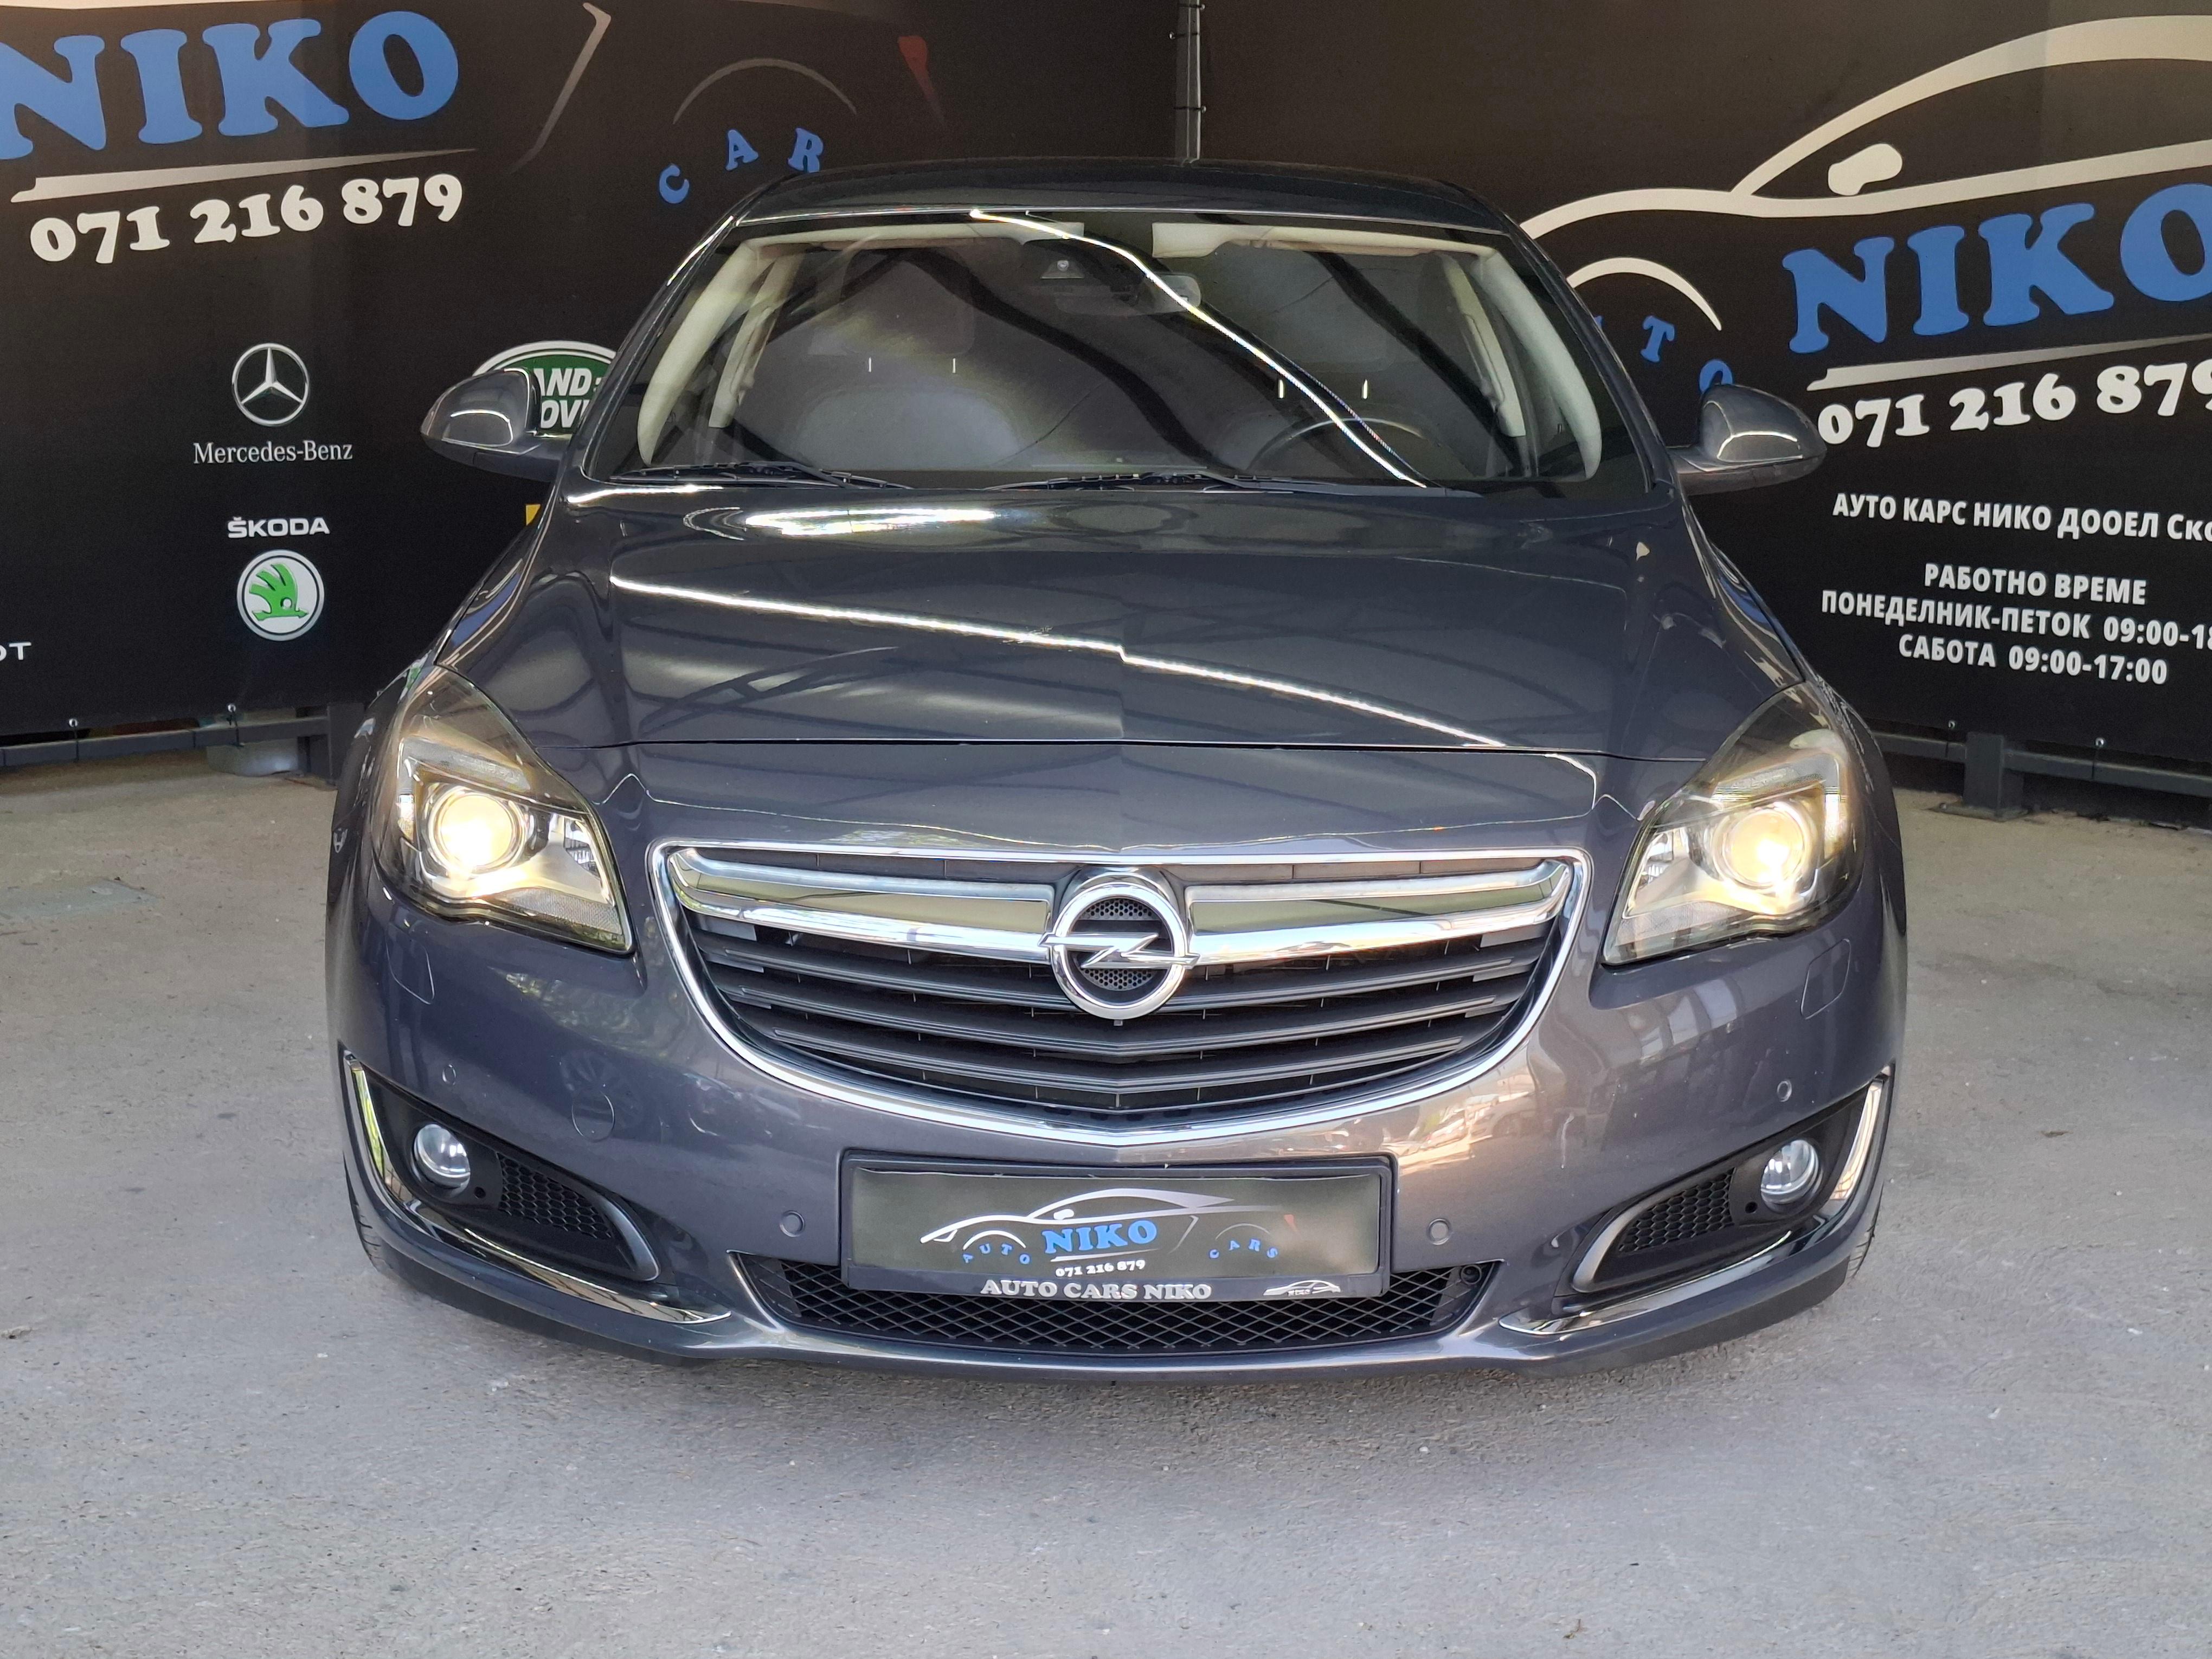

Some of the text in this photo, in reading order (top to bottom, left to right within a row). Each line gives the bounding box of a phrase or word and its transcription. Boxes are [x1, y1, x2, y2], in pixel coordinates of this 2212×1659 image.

[0, 11, 458, 158] NIKO
[30, 173, 462, 264] 071 216 879
[1783, 183, 2212, 354] NIKO
[1818, 394, 1930, 447] 071
[1949, 373, 2076, 431] 216
[193, 440, 353, 464] Mercedes-Benz
[227, 517, 330, 538] ŠKODA
[1832, 493, 1896, 520] АУТО
[1903, 497, 1967, 525] КАРС
[1973, 502, 2052, 531] НИКО
[2057, 507, 2159, 539] ДООЕЛ
[1925, 563, 2146, 605] РАБОТНО ВРЕМЕ
[1822, 590, 2091, 639] ПОНЕДЕЛНИК-ПЕТОК
[1899, 634, 2167, 684] САБОТА 09:00-17:00
[962, 1243, 1031, 1264] AUTO
[1041, 1219, 1158, 1254] NIKO
[1209, 1238, 1278, 1258] CARS
[1055, 1259, 1146, 1277] 071 216 879
[980, 1279, 1212, 1300] AUTO CARS NIKO
